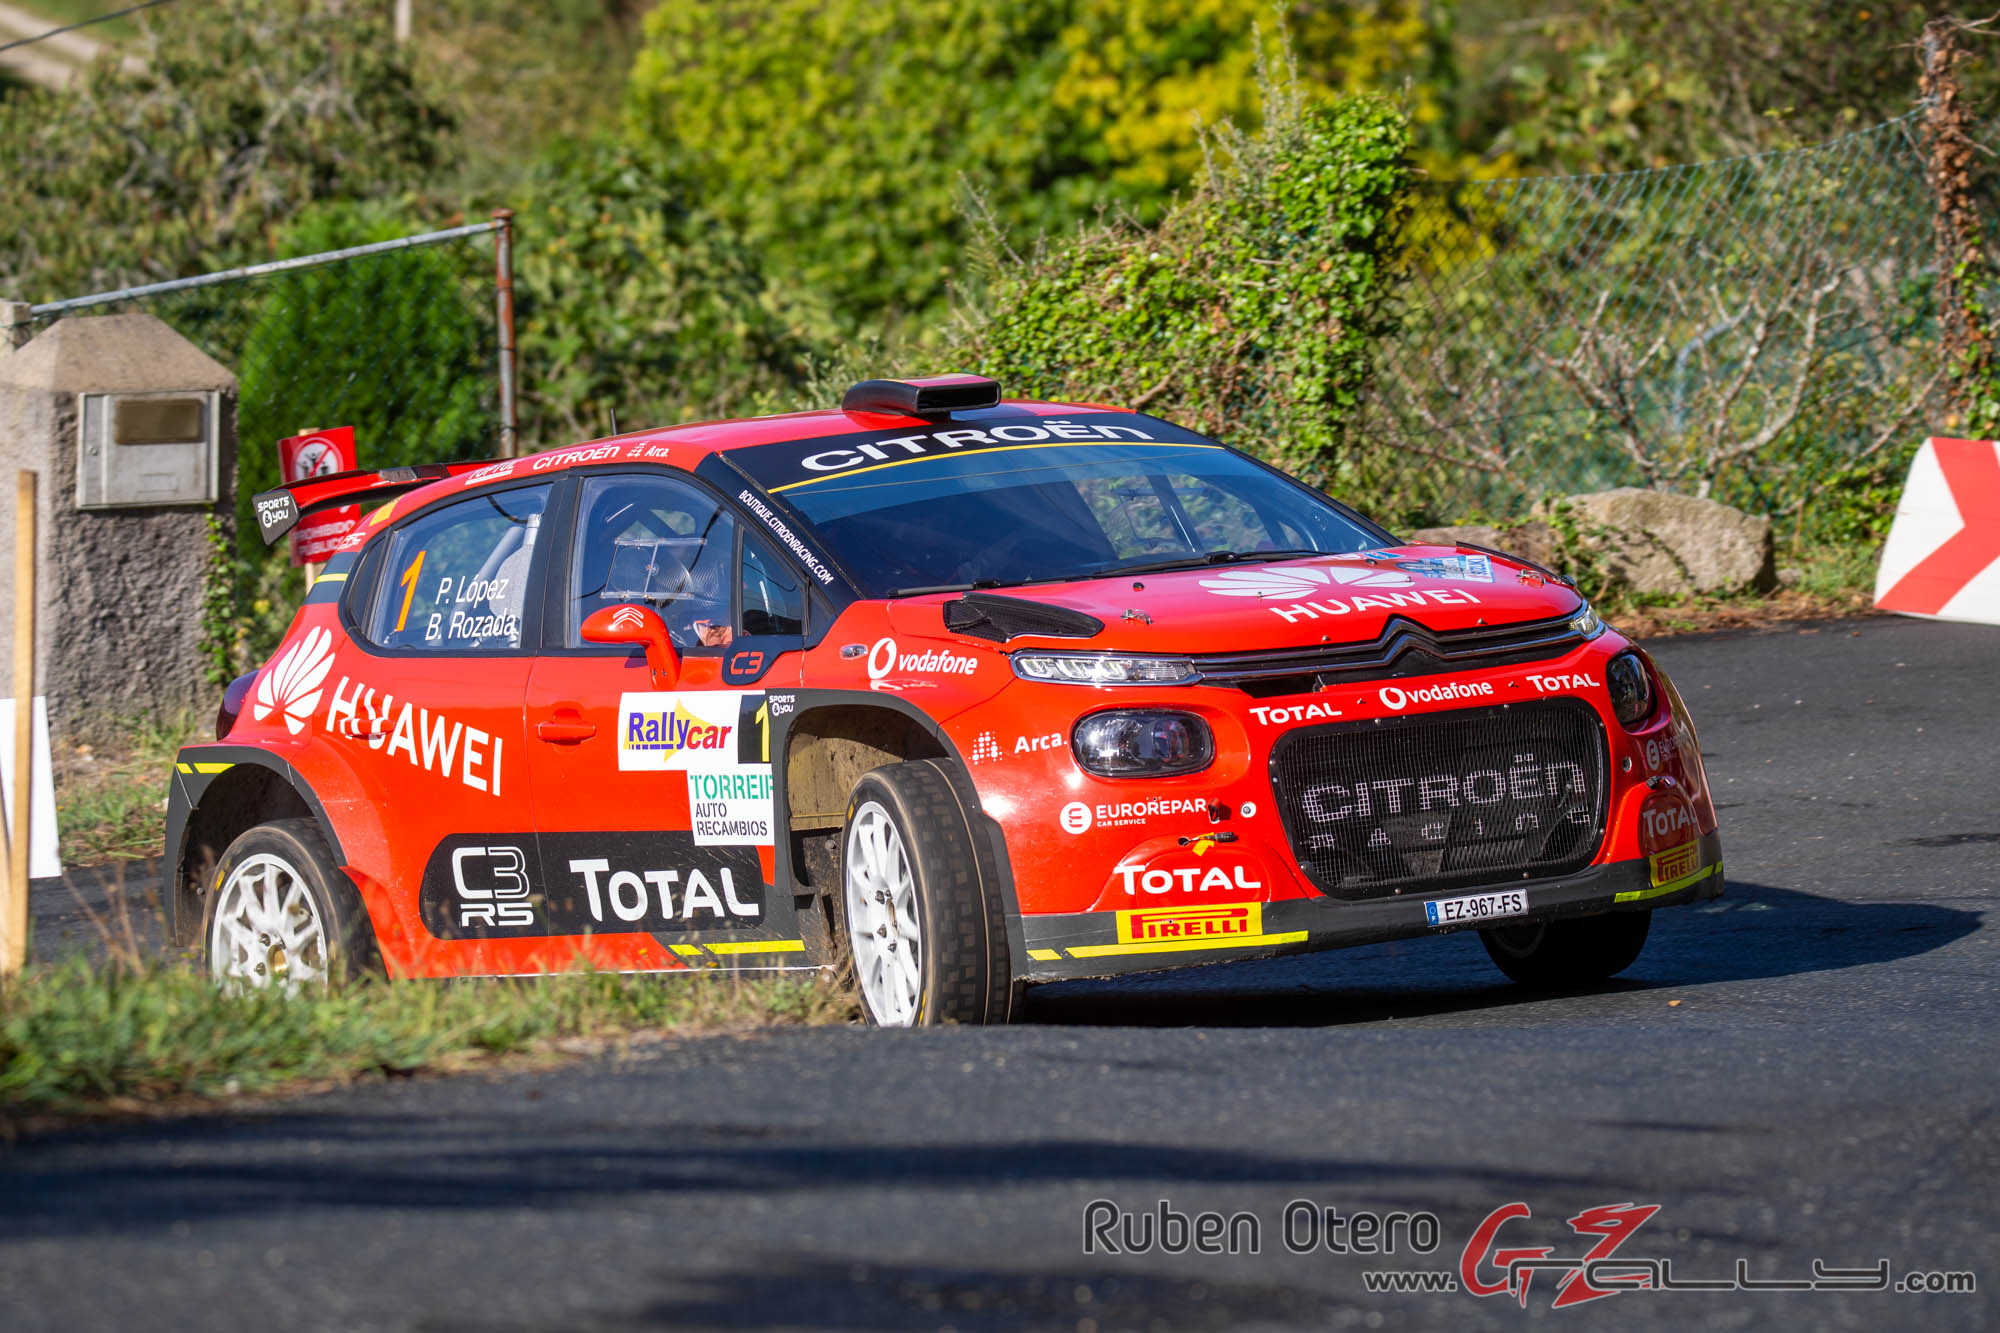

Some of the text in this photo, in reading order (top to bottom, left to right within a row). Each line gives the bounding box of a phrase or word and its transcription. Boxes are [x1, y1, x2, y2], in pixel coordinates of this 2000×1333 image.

[257, 496, 290, 512] SPORTS
[738, 490, 834, 584] BOUTIQUE.CITROENRACING.COM
[395, 551, 426, 632] 1
[435, 574, 509, 605] P. López
[1269, 588, 1481, 623] HUAWEI
[425, 609, 516, 641] B. Rozada
[730, 651, 763, 675] C3
[899, 649, 978, 675] vodafone
[1408, 680, 1494, 705] vodafone
[1526, 672, 1600, 692] TOTAL
[769, 695, 795, 704] SPORTS
[1250, 702, 1342, 726] TOTAL
[325, 675, 503, 797] HUAWEI
[628, 711, 732, 750] Rallycar
[755, 700, 770, 762] 1
[695, 802, 727, 818] AUTO
[1096, 798, 1207, 820] EUROREPAR
[1097, 818, 1146, 827] CAR SERVICE
[697, 820, 768, 836] RECAMBIOS
[452, 846, 530, 899] C3
[1113, 865, 1261, 895] TOTAL
[569, 858, 759, 922] TOTAL
[1444, 893, 1522, 920] EZ-967-FS
[1130, 907, 1249, 939] PIRELLI
